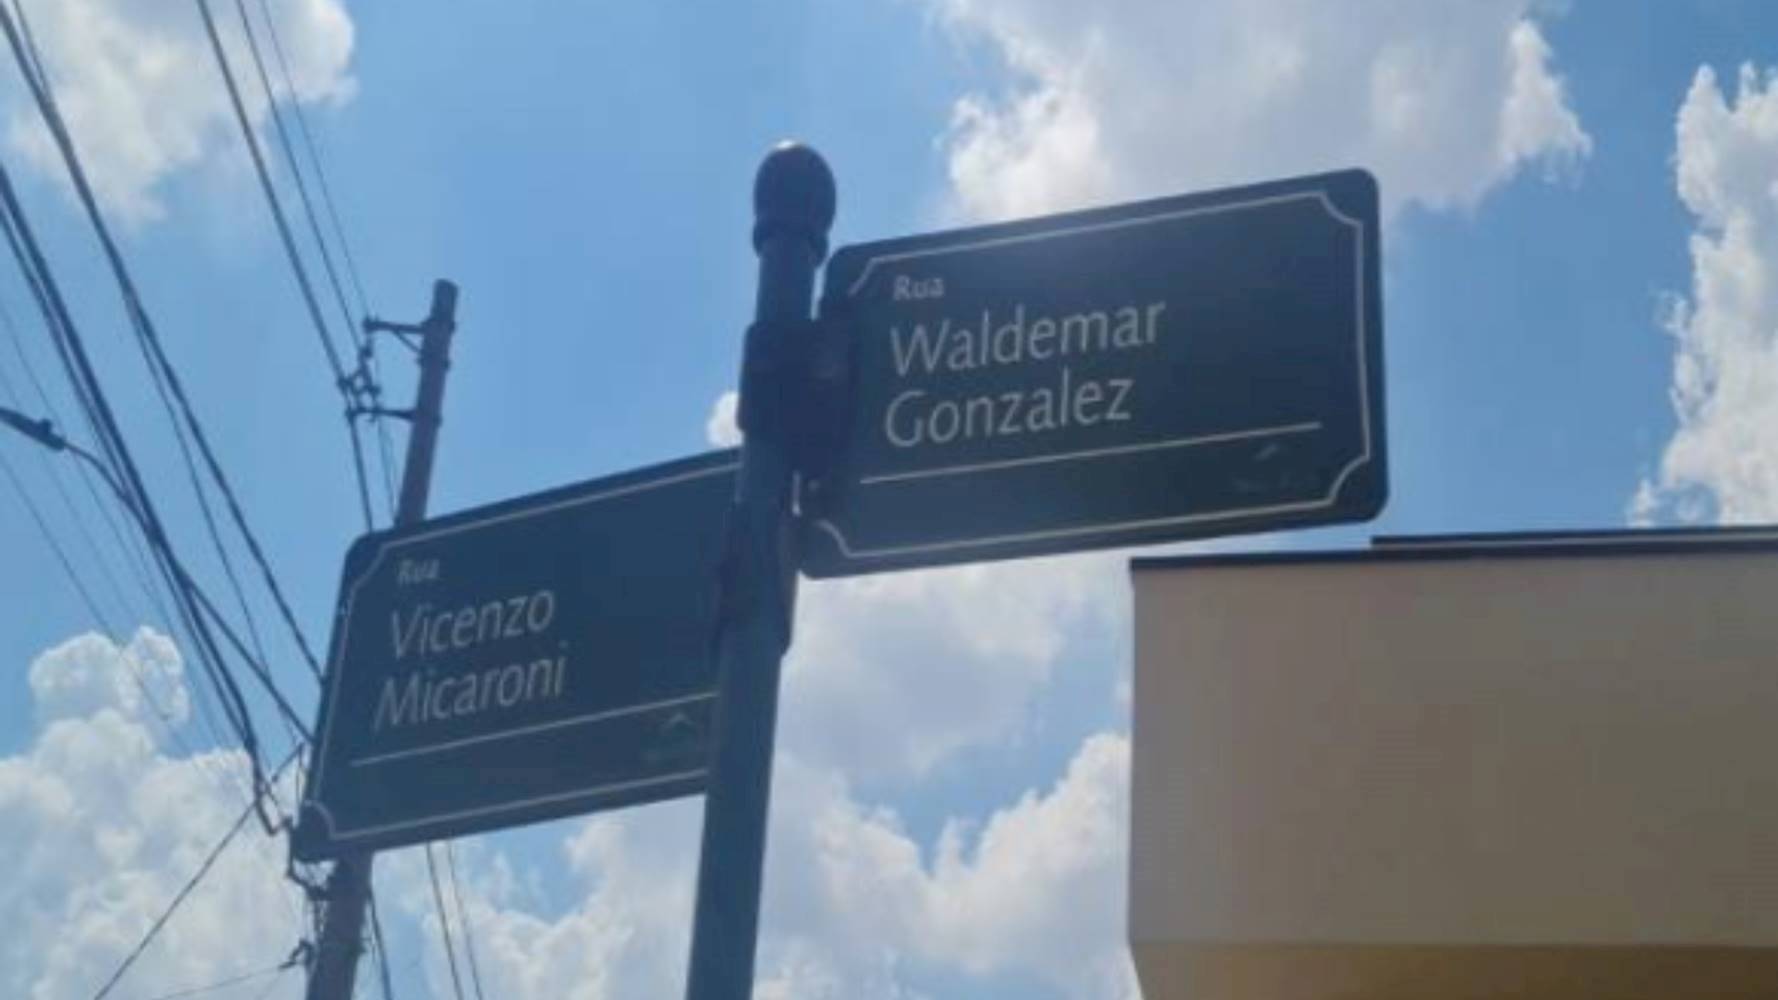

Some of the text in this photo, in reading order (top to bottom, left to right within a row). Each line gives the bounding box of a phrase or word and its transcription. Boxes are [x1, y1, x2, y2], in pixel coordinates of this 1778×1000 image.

[893, 275, 944, 300] Rua
[889, 302, 1166, 377] Waldemar
[885, 365, 1134, 447] Gonzalez
[397, 559, 440, 584] Rua
[391, 589, 554, 660] Vicenzo
[373, 640, 569, 733] Micaroni
